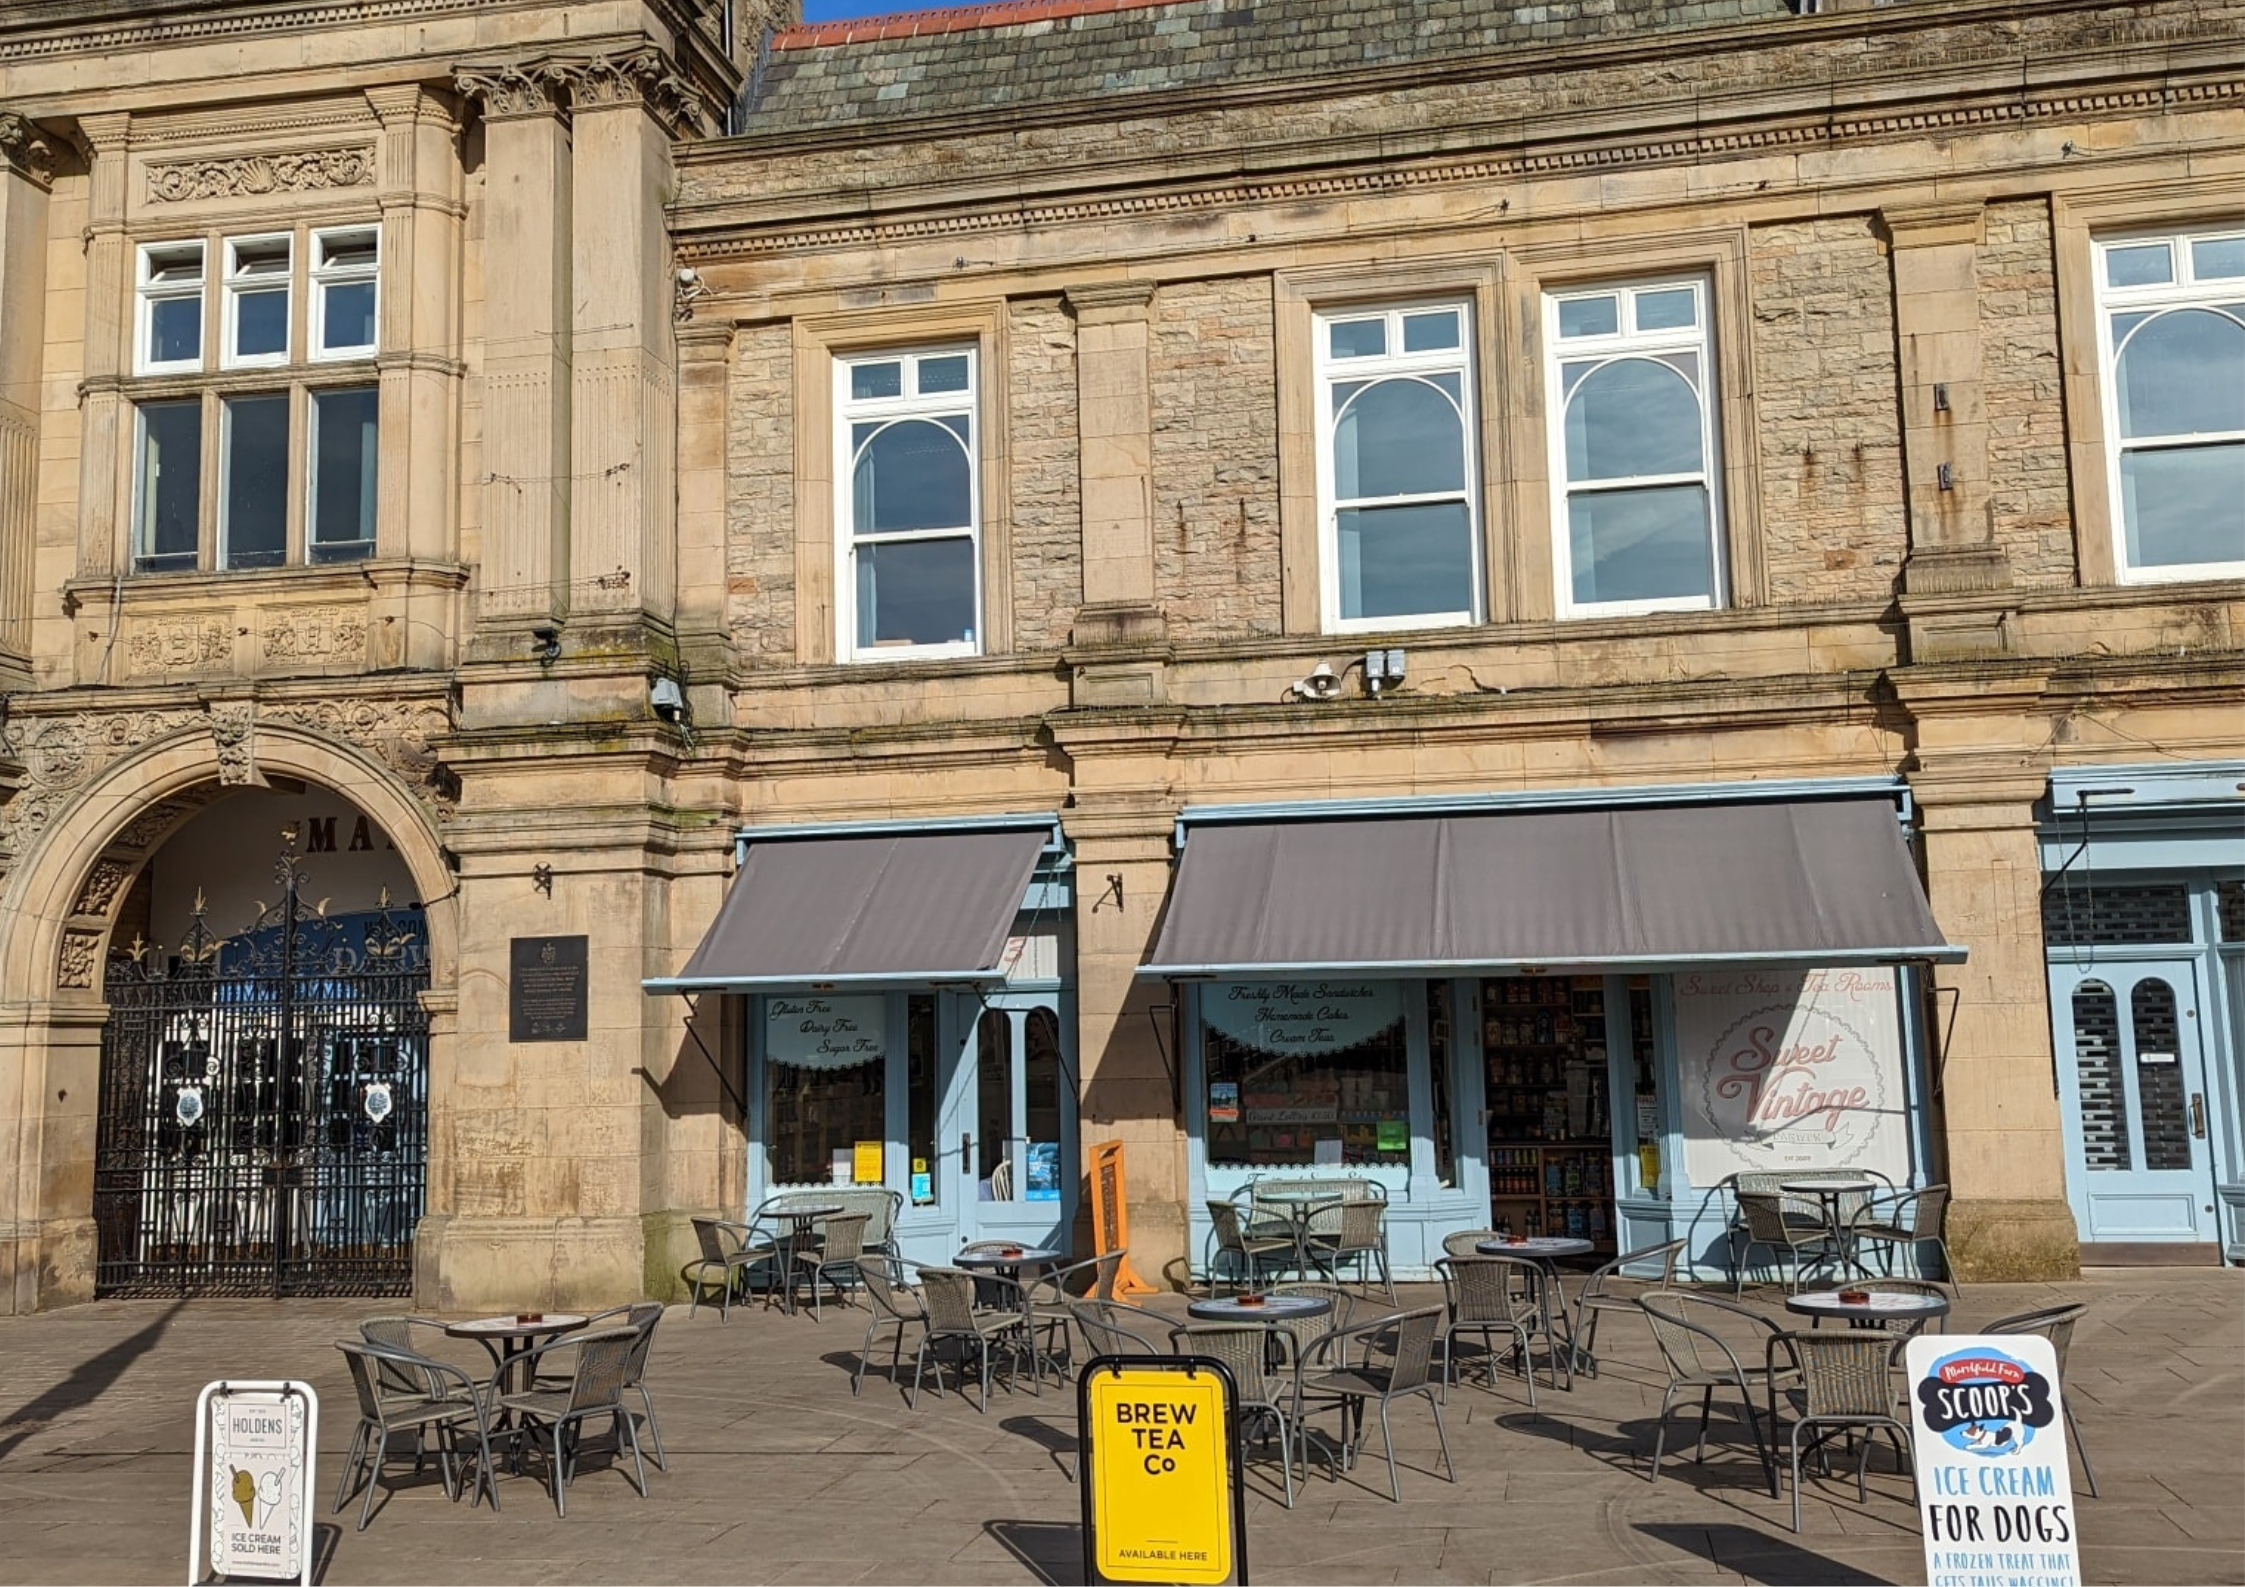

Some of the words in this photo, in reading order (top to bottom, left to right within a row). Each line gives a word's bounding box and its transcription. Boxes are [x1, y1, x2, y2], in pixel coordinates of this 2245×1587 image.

[307, 815, 396, 852] MA
[1228, 986, 1270, 1004] Freshly
[1273, 984, 1309, 1004] Made
[1313, 983, 1375, 999] Sandwiches
[1680, 975, 1730, 996] Sweet
[1735, 974, 1780, 997] Shop
[1797, 972, 1829, 993] Tea
[1834, 972, 1893, 1001] Rooms
[769, 1001, 803, 1020] Gluten
[806, 1000, 831, 1013] Free
[1255, 1007, 1314, 1023] Homemade
[1316, 1006, 1349, 1021] Cakes
[800, 1020, 831, 1037] Dairy
[833, 1019, 858, 1032] Free
[1270, 1029, 1305, 1043] Cream
[1308, 1028, 1335, 1042] Teas
[817, 1039, 850, 1057] Sugar
[853, 1038, 879, 1052] Free
[1730, 1026, 1843, 1072] Sweet
[1716, 1065, 1870, 1132] Vintage
[1937, 1384, 2033, 1419] SCOOP'S
[1117, 1403, 1197, 1424] BREW
[233, 1418, 283, 1435] HOLDENS
[1131, 1428, 1185, 1450] TEA
[1144, 1454, 1176, 1475] Co
[1934, 1466, 1970, 1496] ICE
[1979, 1466, 2055, 1497] CREAM
[1929, 1504, 1984, 1542] FOR
[1994, 1504, 2070, 1543] DOGS
[231, 1533, 247, 1543] ICE
[248, 1533, 281, 1544] CREAM
[231, 1543, 256, 1553] SOLD
[258, 1544, 281, 1555] HERE
[1118, 1549, 1176, 1560] AVAILABLE
[1179, 1551, 1208, 1561] HERE
[1934, 1552, 1942, 1570] A
[1946, 1552, 1993, 1570] FROZEN
[1997, 1553, 2034, 1570] TREAT
[2039, 1553, 2070, 1570] THAT
